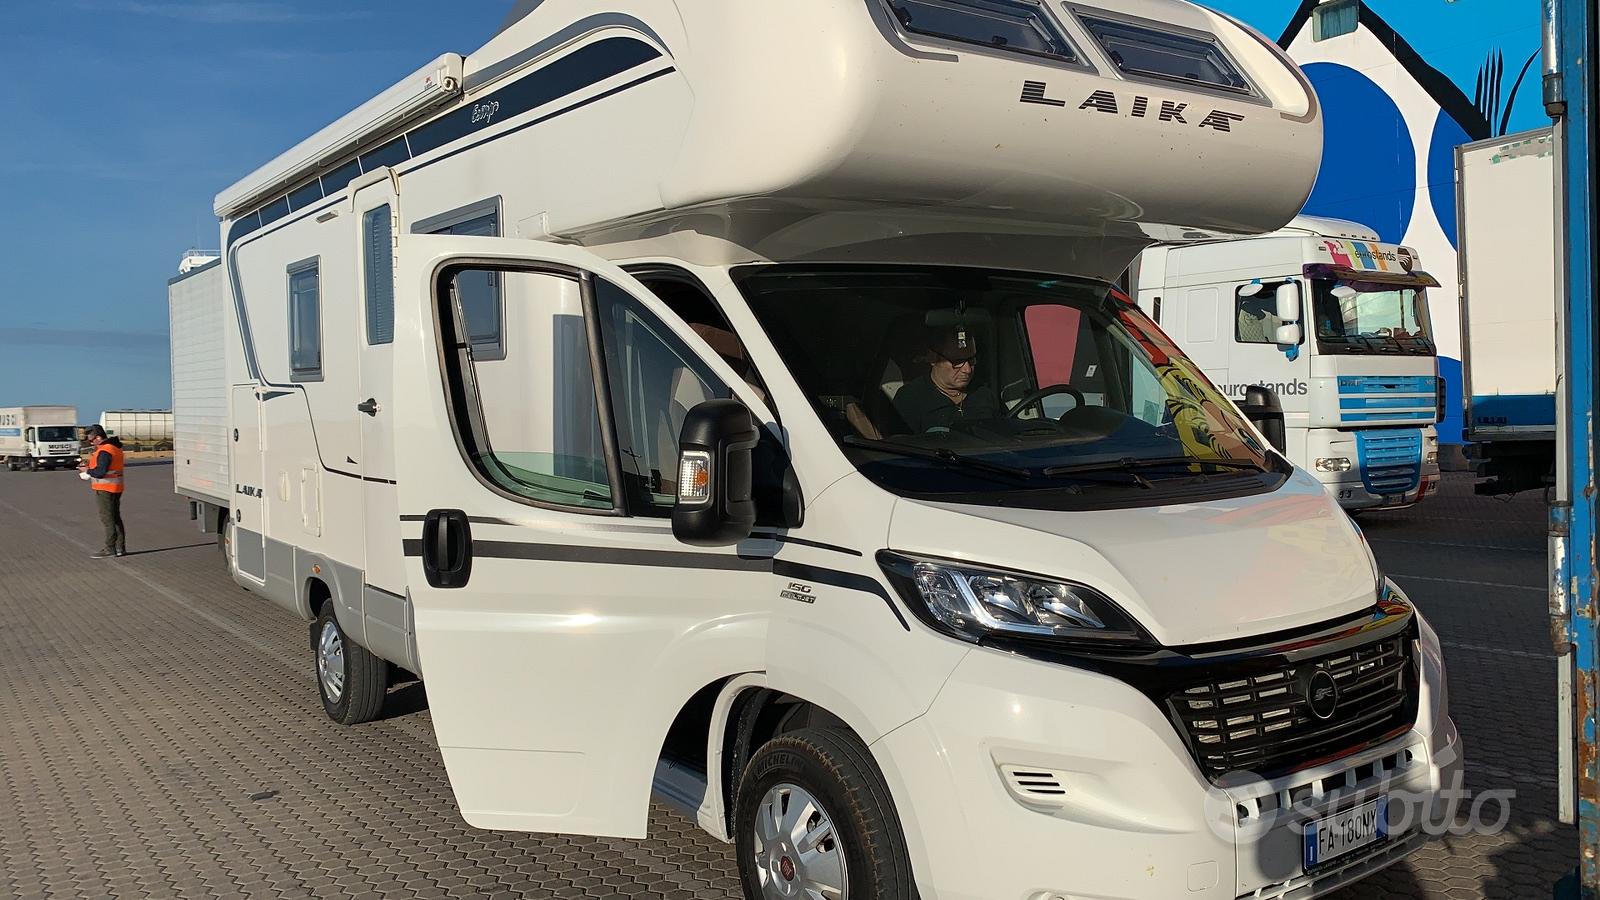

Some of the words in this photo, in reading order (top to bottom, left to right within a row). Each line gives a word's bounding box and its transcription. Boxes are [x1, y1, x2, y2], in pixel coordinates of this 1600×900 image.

[1020, 80, 1245, 132] LAIKA
[1355, 249, 1396, 261] eurostands
[1217, 378, 1308, 396] euroands
[236, 484, 262, 498] LAIKA
